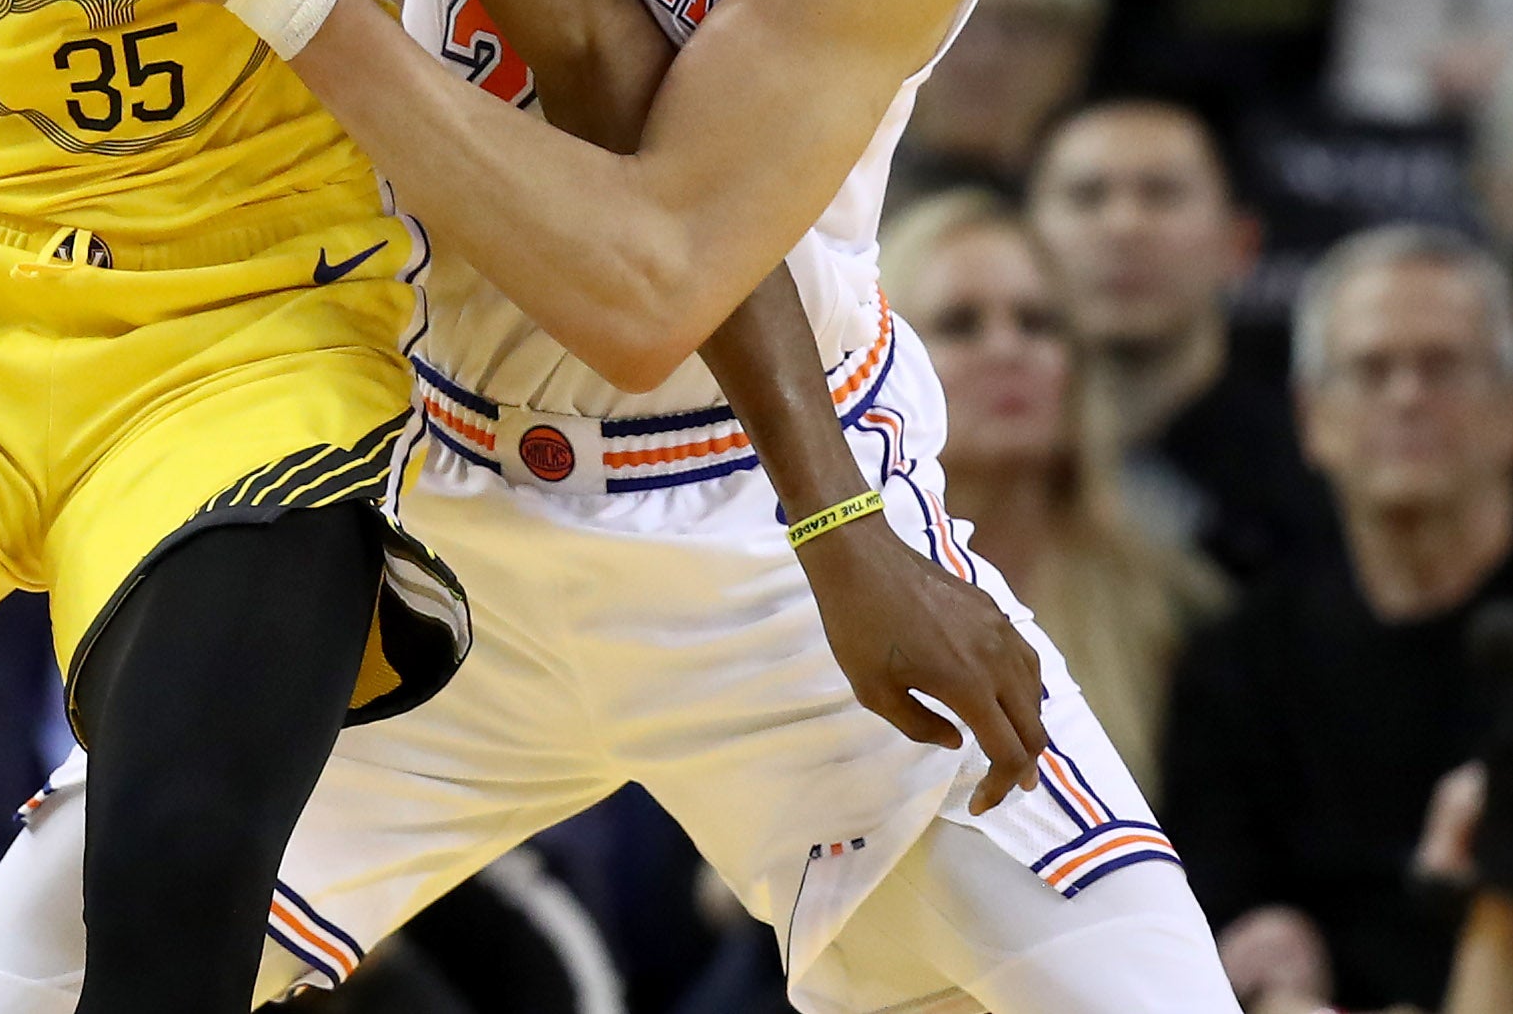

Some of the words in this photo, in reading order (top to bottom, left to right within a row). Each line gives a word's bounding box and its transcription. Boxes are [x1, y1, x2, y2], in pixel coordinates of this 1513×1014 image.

[54, 22, 185, 132] 35
[840, 501, 864, 518] THE
[789, 511, 837, 542] LEADER
